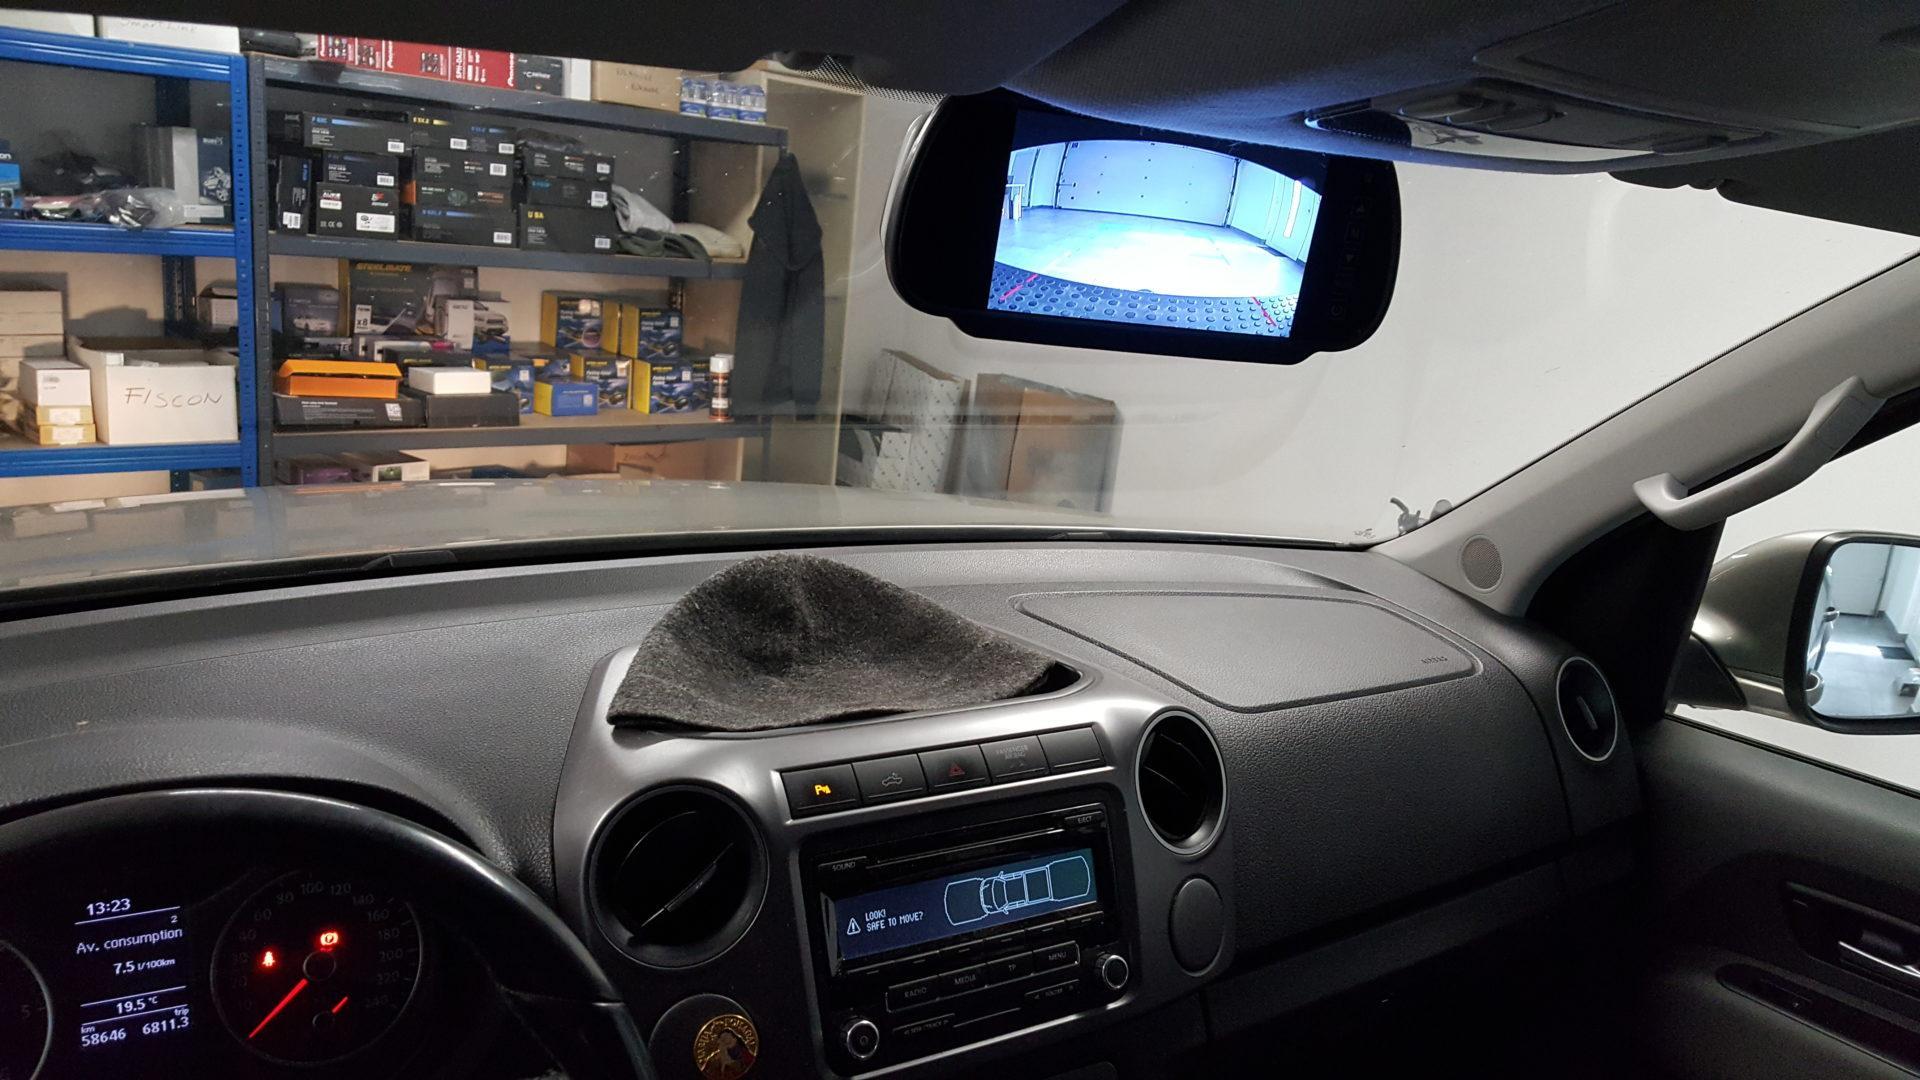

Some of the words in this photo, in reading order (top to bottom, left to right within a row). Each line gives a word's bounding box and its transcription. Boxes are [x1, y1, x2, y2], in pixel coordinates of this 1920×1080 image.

[125, 387, 223, 408] FISCON
[86, 897, 131, 916] 13:23
[170, 915, 178, 923] 2
[864, 909, 886, 921] LOOK!
[865, 919, 887, 932] SAFE
[888, 917, 898, 928] TO
[899, 912, 924, 925] MOVE?
[76, 942, 100, 954] Av.
[103, 928, 183, 950] consumption
[113, 961, 135, 975] 7.5
[954, 973, 977, 986] MEDIA
[904, 986, 928, 999] RADIO
[116, 998, 146, 1014] 19.5
[174, 1007, 189, 1016] trip
[81, 1026, 95, 1034] km
[81, 1027, 127, 1047] 58646
[142, 1016, 189, 1035] 6811.3
